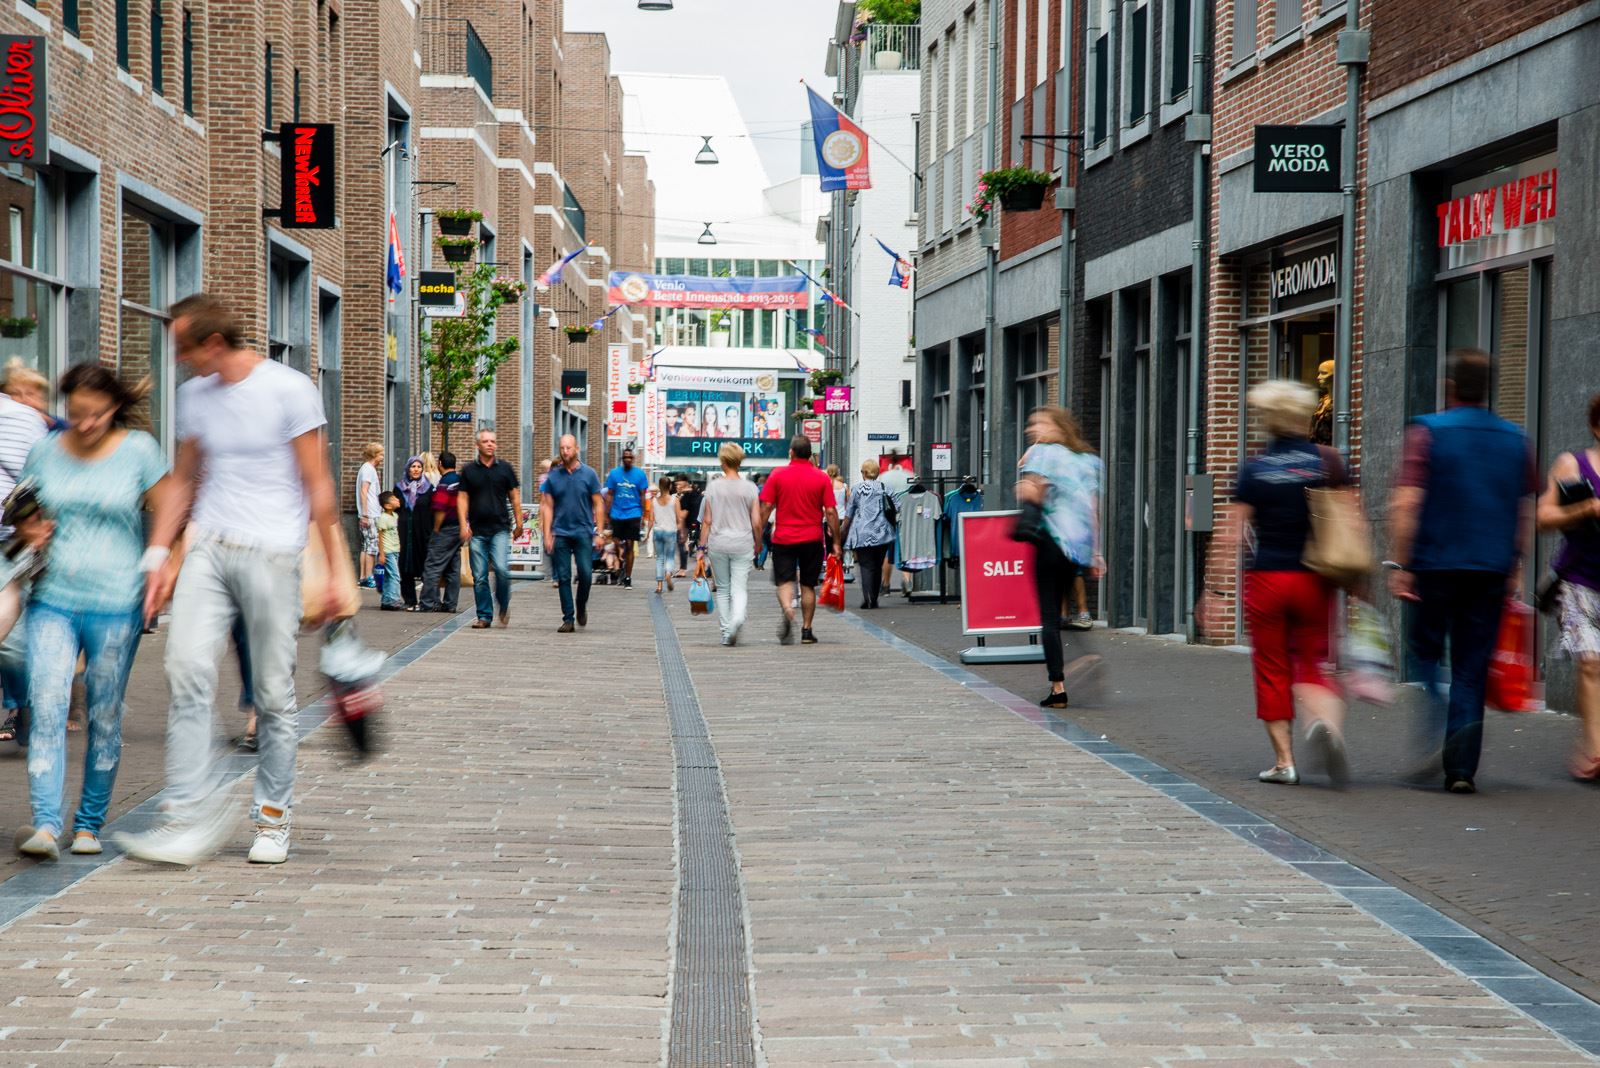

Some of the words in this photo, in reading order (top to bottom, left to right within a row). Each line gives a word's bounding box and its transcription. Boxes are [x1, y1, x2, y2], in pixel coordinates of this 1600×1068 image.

[1270, 144, 1325, 158] VERO
[1267, 158, 1330, 172] MODA
[1436, 186, 1497, 248] TALLY
[420, 284, 455, 293] sacha
[654, 280, 685, 291] Venlo
[654, 291, 682, 302] Beste
[825, 400, 850, 411] bart
[691, 441, 764, 454] PRIRK
[983, 560, 1024, 577] SALE
